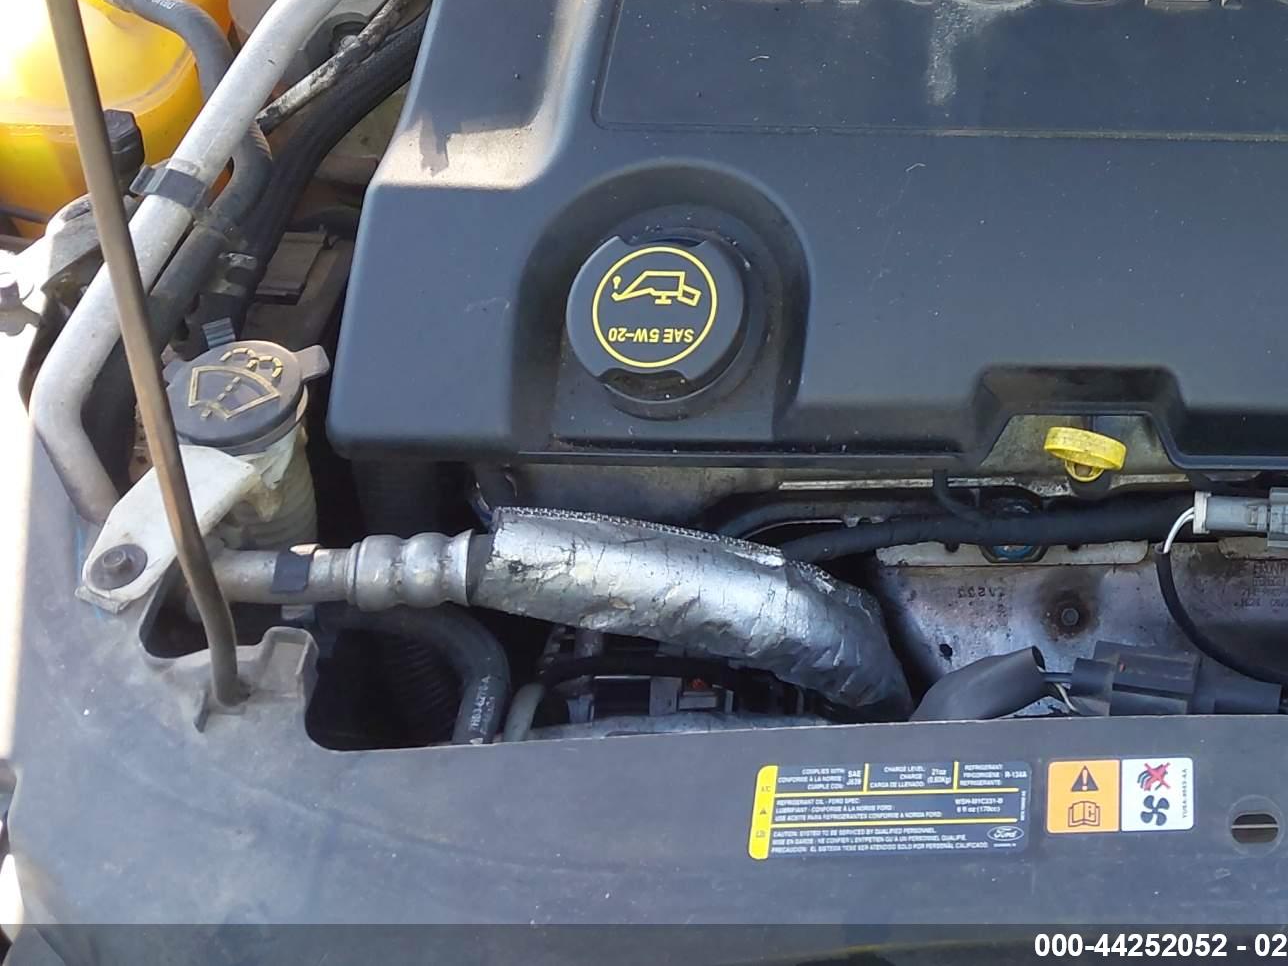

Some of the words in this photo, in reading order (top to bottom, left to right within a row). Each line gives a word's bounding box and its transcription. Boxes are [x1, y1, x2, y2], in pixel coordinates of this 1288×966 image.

[608, 327, 660, 342] 5W-20
[663, 328, 695, 343] SAE
[847, 770, 862, 778] SAE
[991, 827, 1018, 839] Ford
